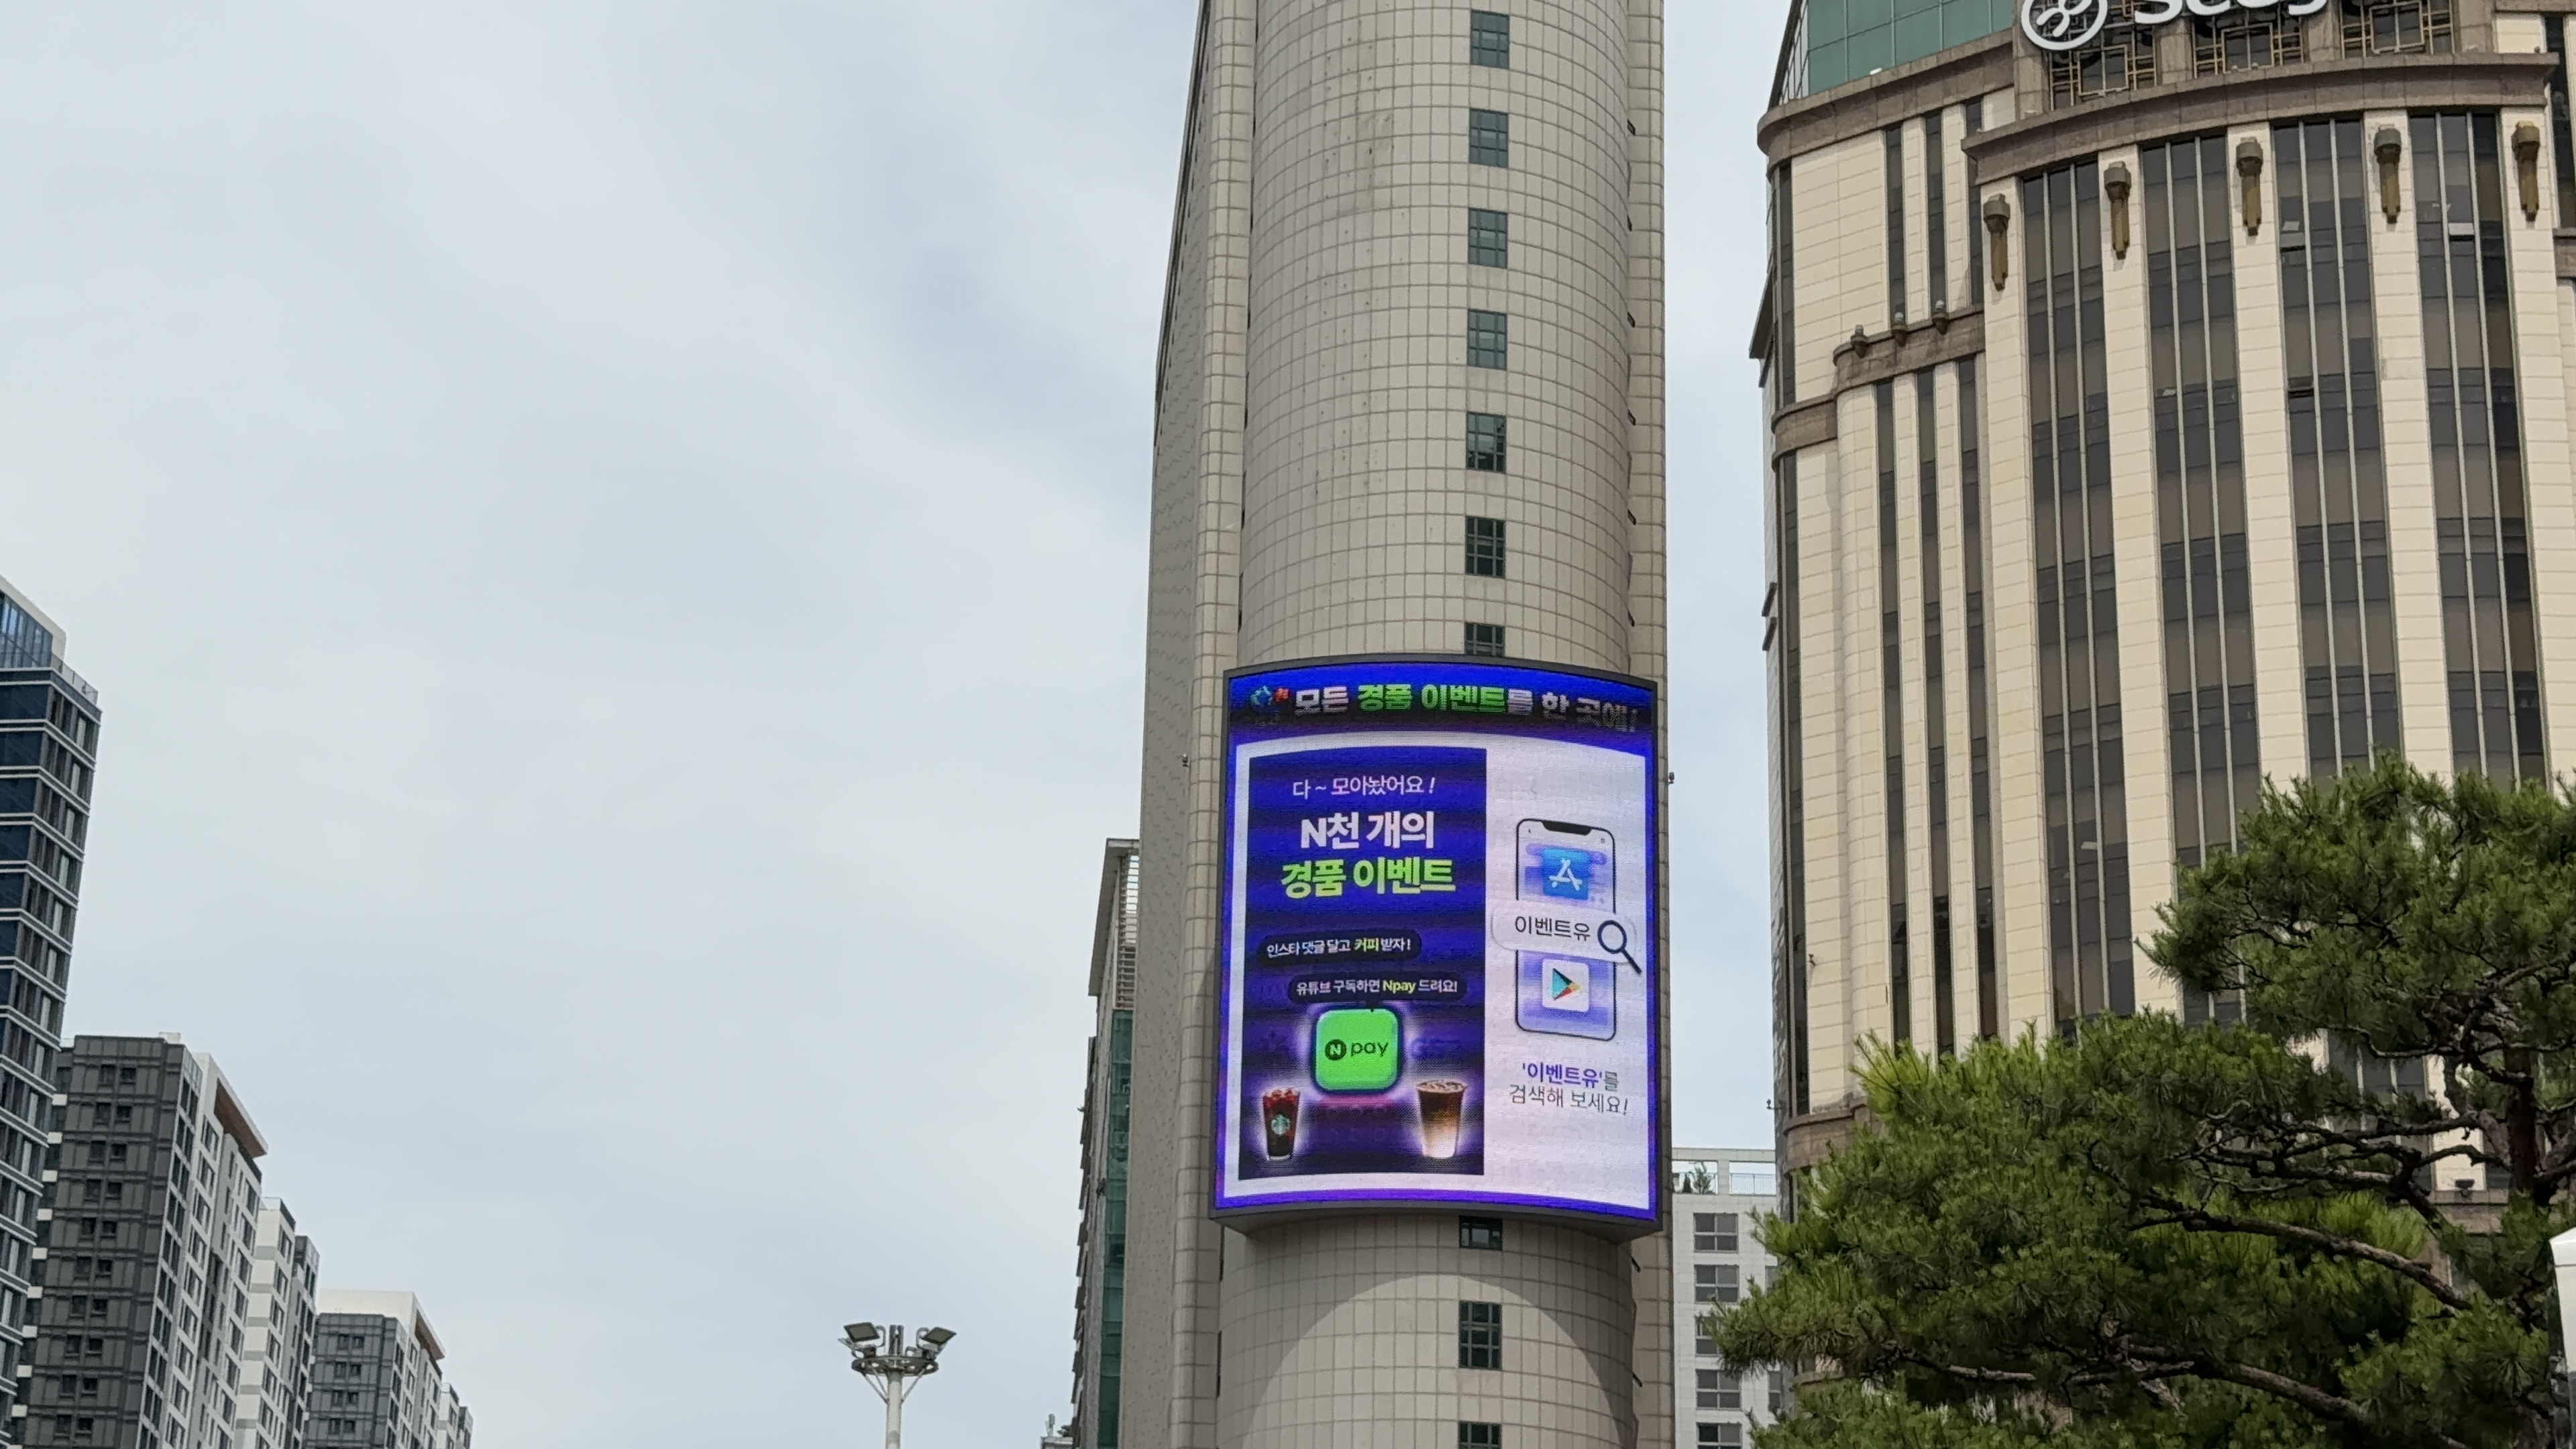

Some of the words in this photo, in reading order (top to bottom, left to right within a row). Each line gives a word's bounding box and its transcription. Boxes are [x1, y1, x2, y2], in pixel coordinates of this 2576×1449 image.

[1295, 686, 1349, 715] 모든
[1358, 684, 1413, 711] 경품
[1421, 684, 1534, 716] 이벤트를
[1542, 691, 1570, 720] 한
[1301, 811, 1359, 849] N천
[1366, 810, 1434, 849] 개의
[1281, 859, 1346, 899] 경품
[1353, 857, 1456, 894] 이벤트
[1515, 916, 1591, 942] 이벤트유
[1267, 941, 1300, 958] 인스타
[1302, 940, 1325, 954] 댓글
[1327, 938, 1351, 953] 달고
[1354, 937, 1379, 952] 커피
[1297, 981, 1331, 996] 유튜브
[1334, 979, 1381, 993] 구독하면
[1383, 980, 1416, 994] Npay
[1510, 1084, 1564, 1108] 검색해
[1570, 1091, 1629, 1116] 보세요!
